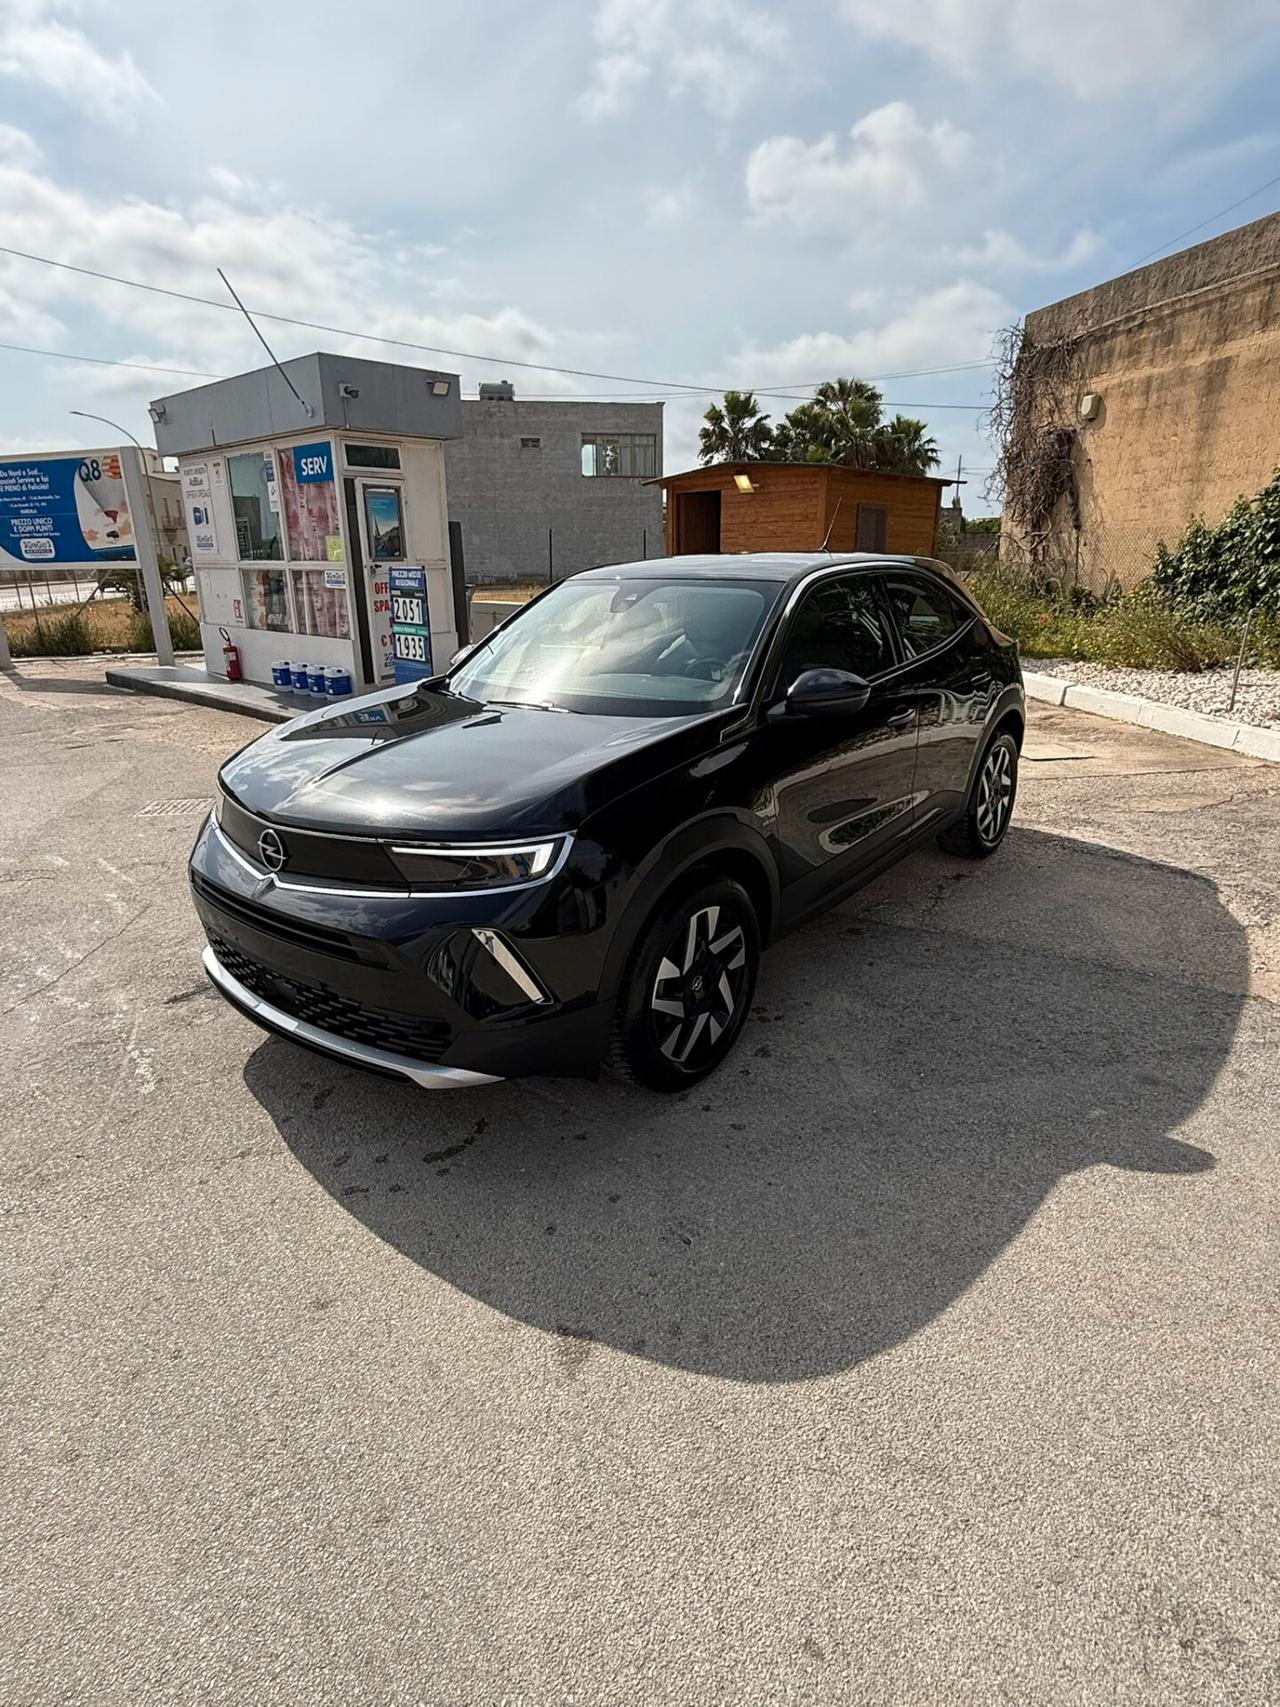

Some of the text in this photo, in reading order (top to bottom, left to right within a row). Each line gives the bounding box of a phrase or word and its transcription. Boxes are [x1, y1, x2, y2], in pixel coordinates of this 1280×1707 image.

[79, 459, 101, 482] Q8
[300, 456, 327, 476] SERV
[32, 517, 53, 525] UNICO
[395, 598, 421, 622] 2051
[397, 636, 424, 659] 1935
